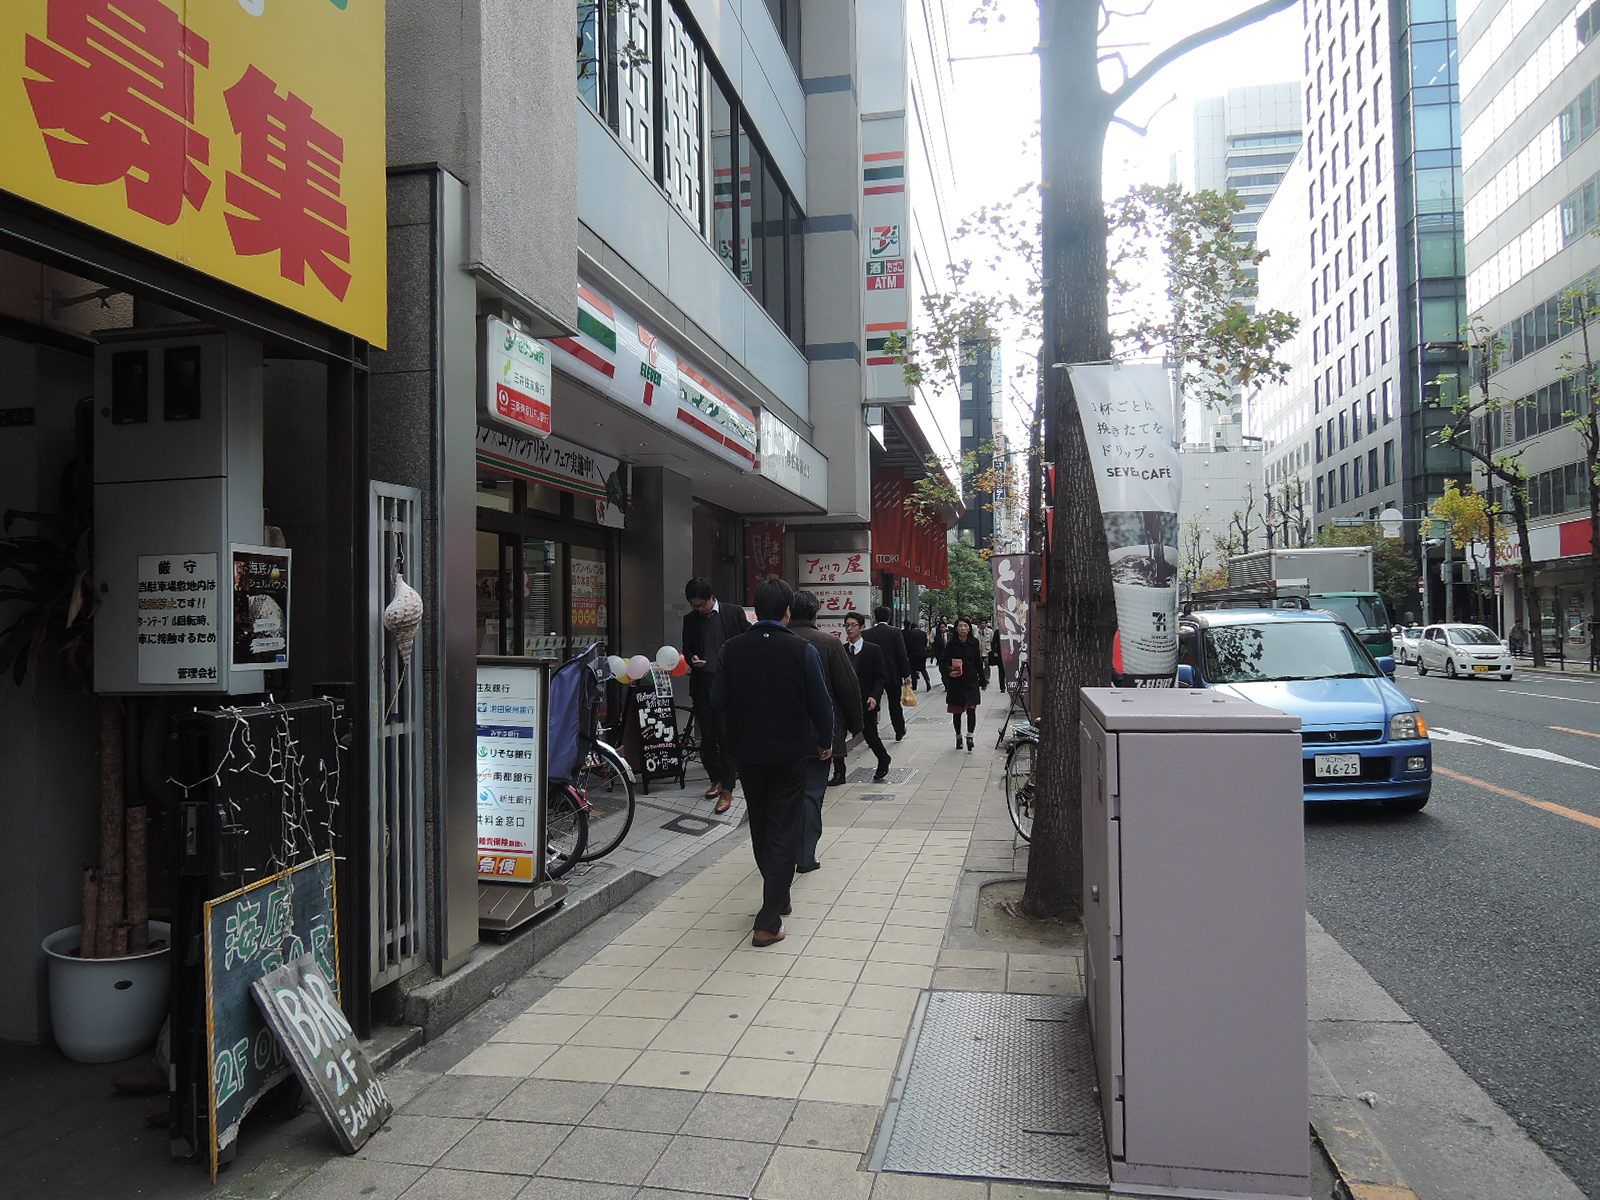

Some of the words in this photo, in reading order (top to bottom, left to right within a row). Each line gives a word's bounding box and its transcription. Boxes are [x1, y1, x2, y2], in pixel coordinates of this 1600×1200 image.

[869, 261, 883, 275] 酒
[886, 260, 904, 273] たばこ
[874, 275, 897, 289] ATM
[1097, 421, 1163, 437] 挽きたてを
[876, 554, 900, 564] ITOKI
[138, 632, 217, 645] 車に接触するため
[177, 667, 217, 680] 管理会社
[489, 749, 533, 761] りそな銀行
[1325, 763, 1358, 775] 46-25
[492, 771, 533, 783] 南都銀行
[499, 794, 533, 806] 新生銀行
[275, 973, 353, 1059] BAR
[215, 1036, 250, 1109] 2F
[326, 1049, 358, 1097] 2F
